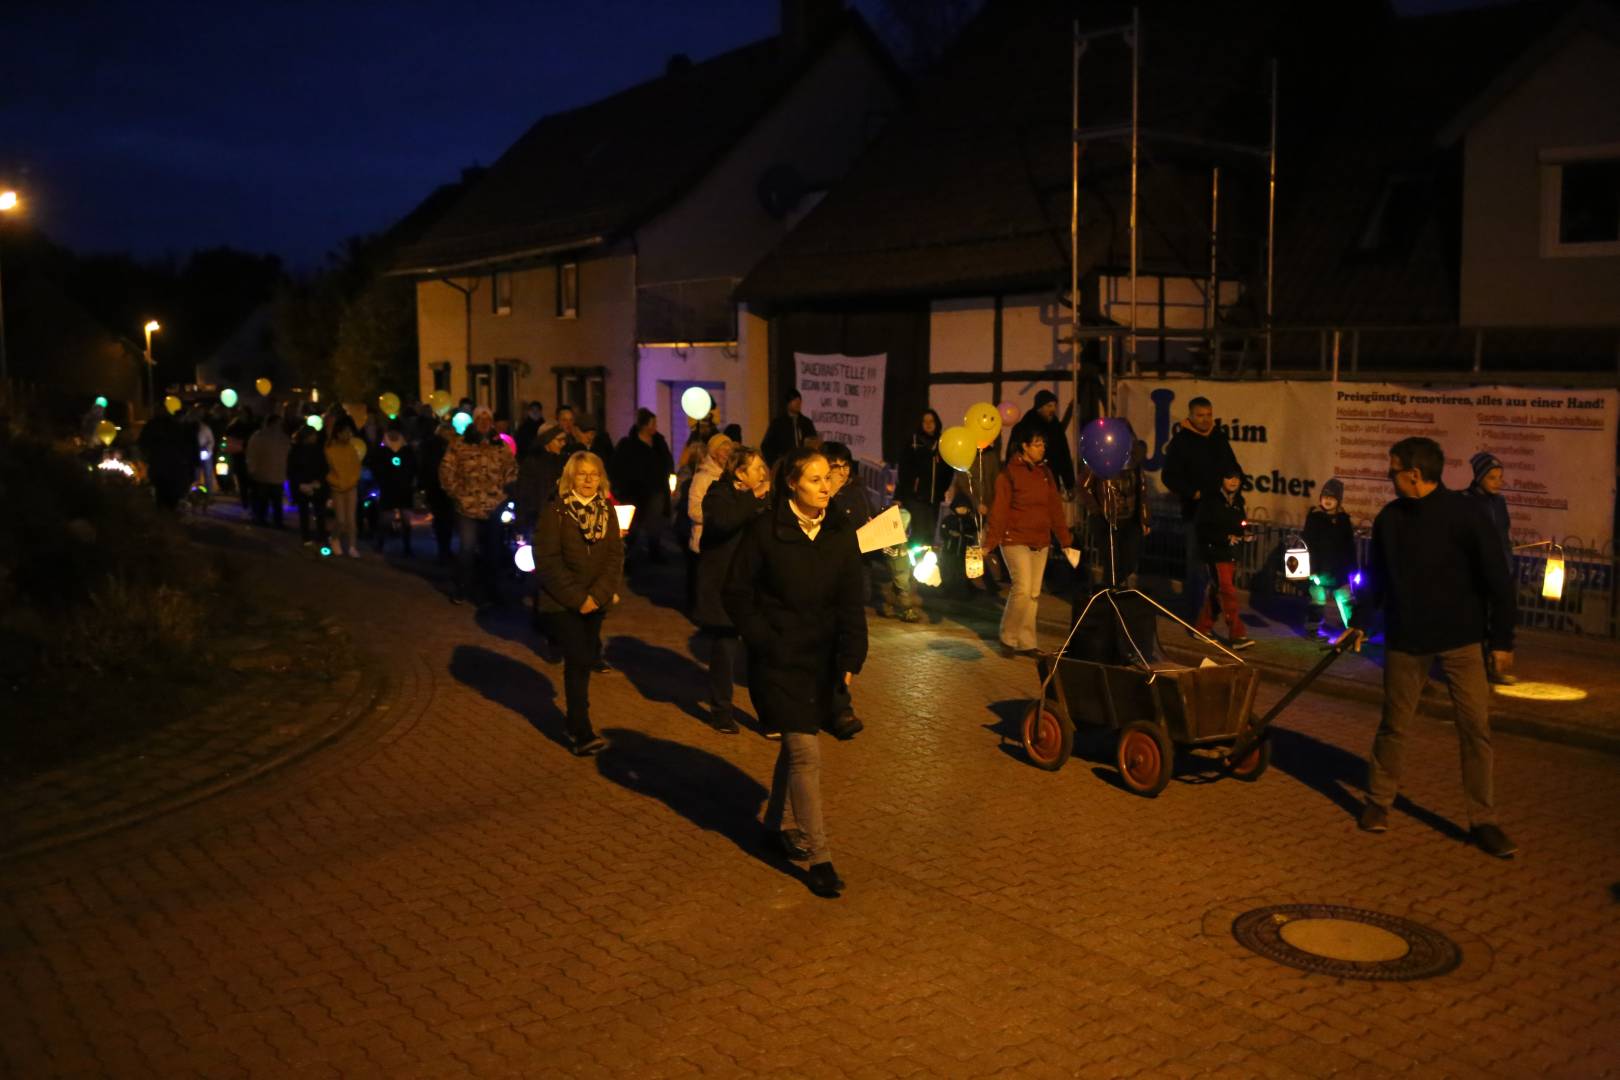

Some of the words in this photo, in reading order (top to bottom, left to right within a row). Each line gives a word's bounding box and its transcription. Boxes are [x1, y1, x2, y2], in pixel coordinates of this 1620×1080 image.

[1337, 391, 1407, 405] Preisgünstig
[1410, 394, 1473, 406] renovieren,
[1476, 395, 1503, 406] alles
[1506, 399, 1527, 408] aus
[1530, 397, 1564, 409] einer
[1567, 397, 1605, 409] Hand!
[1371, 408, 1386, 418] und
[1510, 414, 1527, 424] und
[1242, 470, 1316, 498] scher
